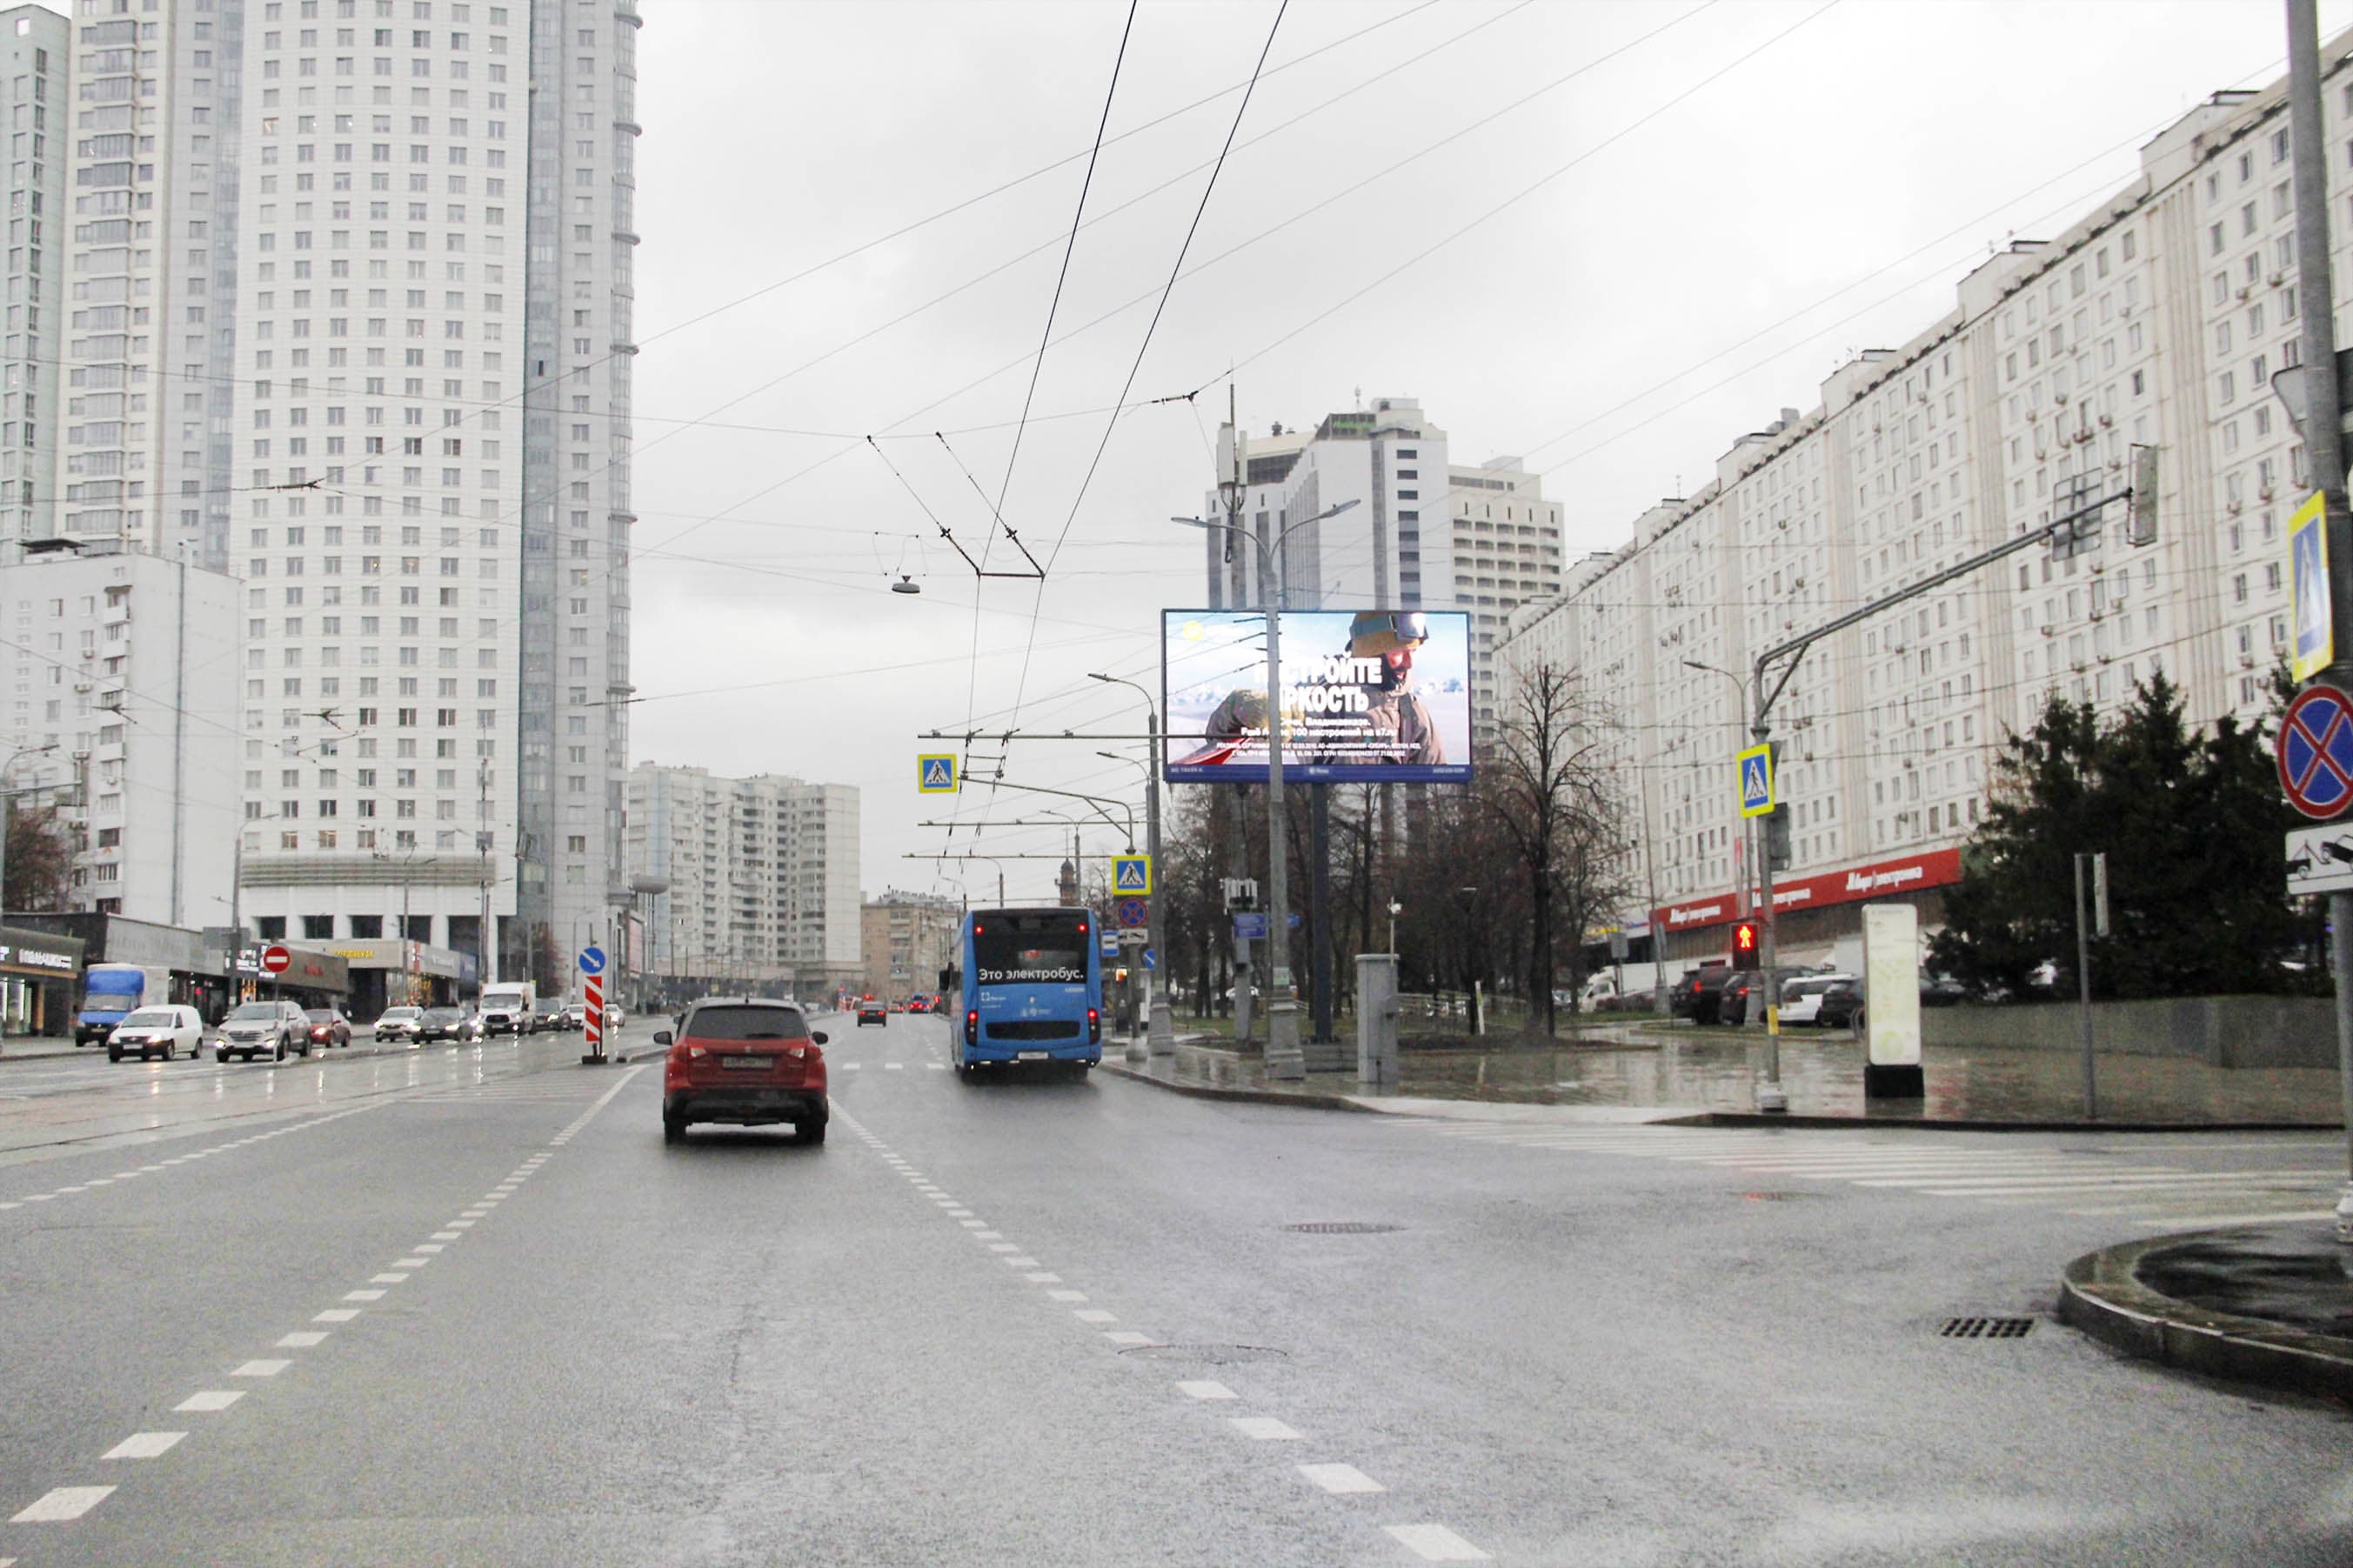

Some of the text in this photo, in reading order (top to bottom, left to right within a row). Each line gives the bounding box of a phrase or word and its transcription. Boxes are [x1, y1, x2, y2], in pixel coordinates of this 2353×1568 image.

[1253, 651, 1382, 684] НСТРОЙТЕ
[1279, 685, 1369, 712] РКОСТЬ
[1292, 726, 1307, 737] 100
[979, 966, 1084, 981] Это электробус.
